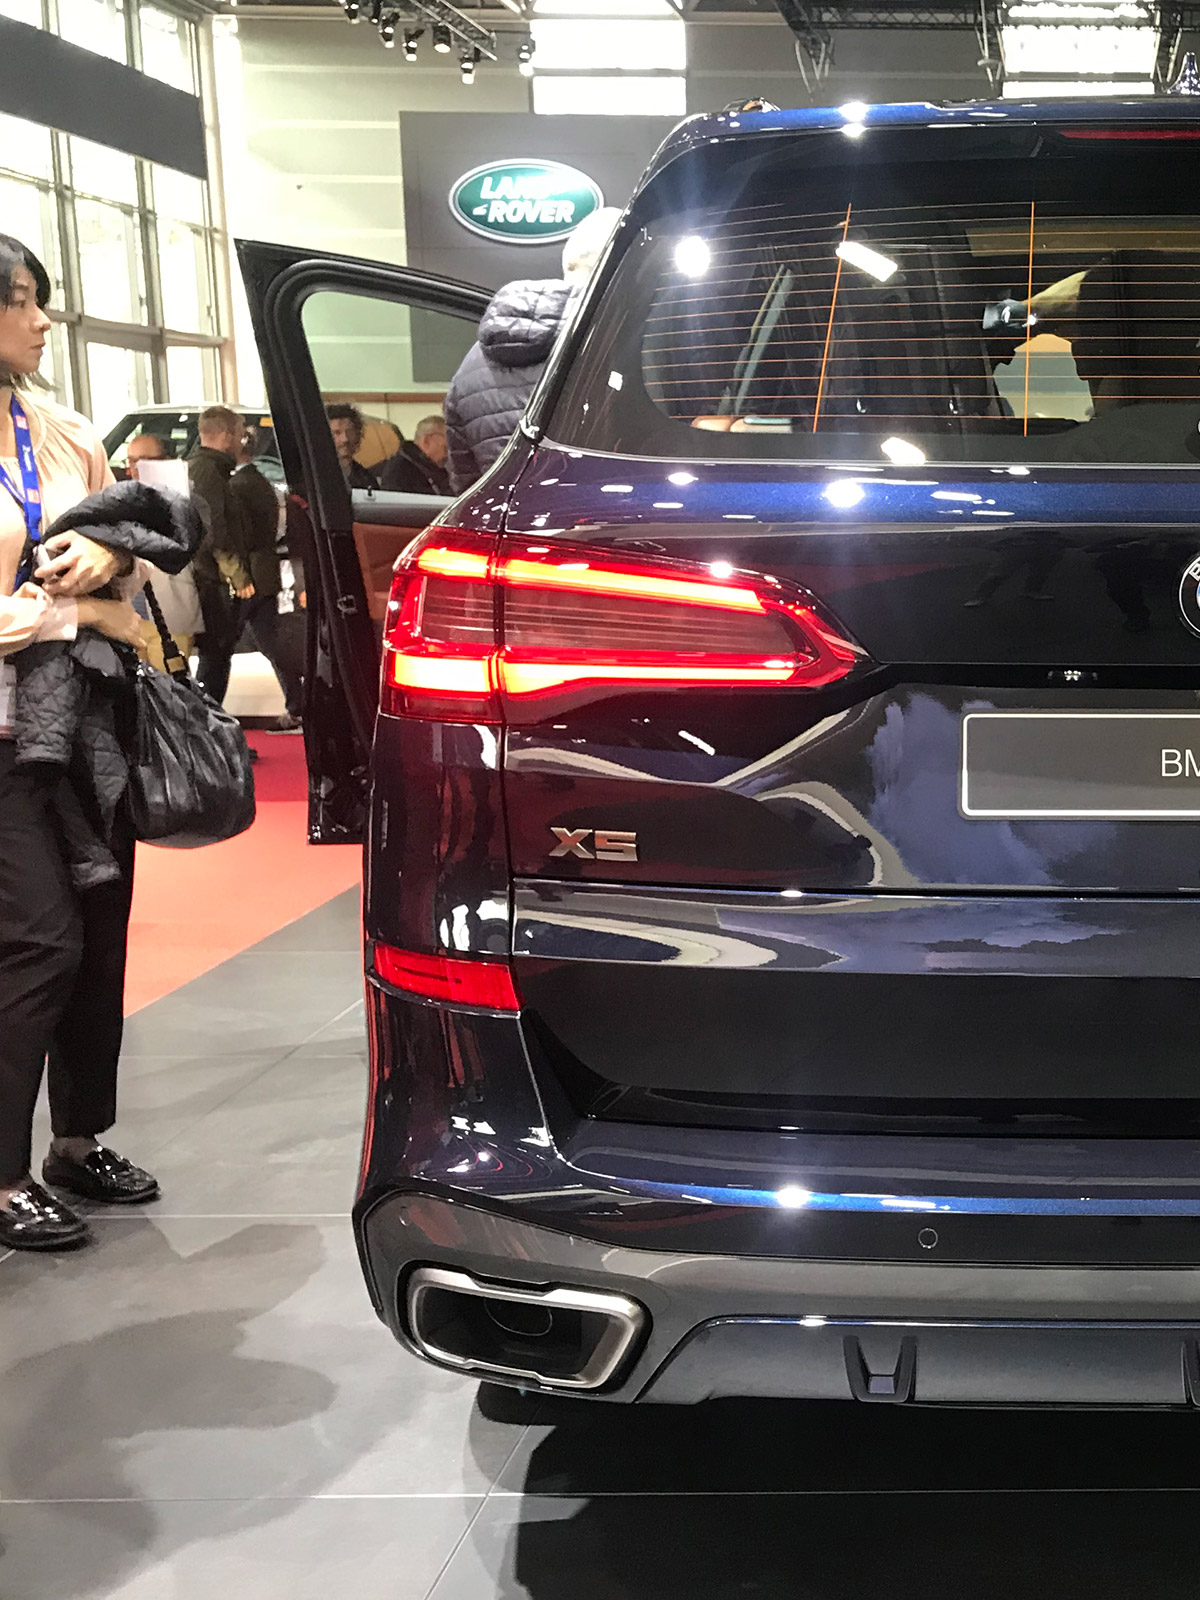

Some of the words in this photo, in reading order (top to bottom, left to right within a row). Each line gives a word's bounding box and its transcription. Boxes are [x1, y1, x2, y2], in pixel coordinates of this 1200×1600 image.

[480, 176, 557, 200] LAN
[487, 200, 576, 223] ROVER
[548, 826, 639, 862] X5
